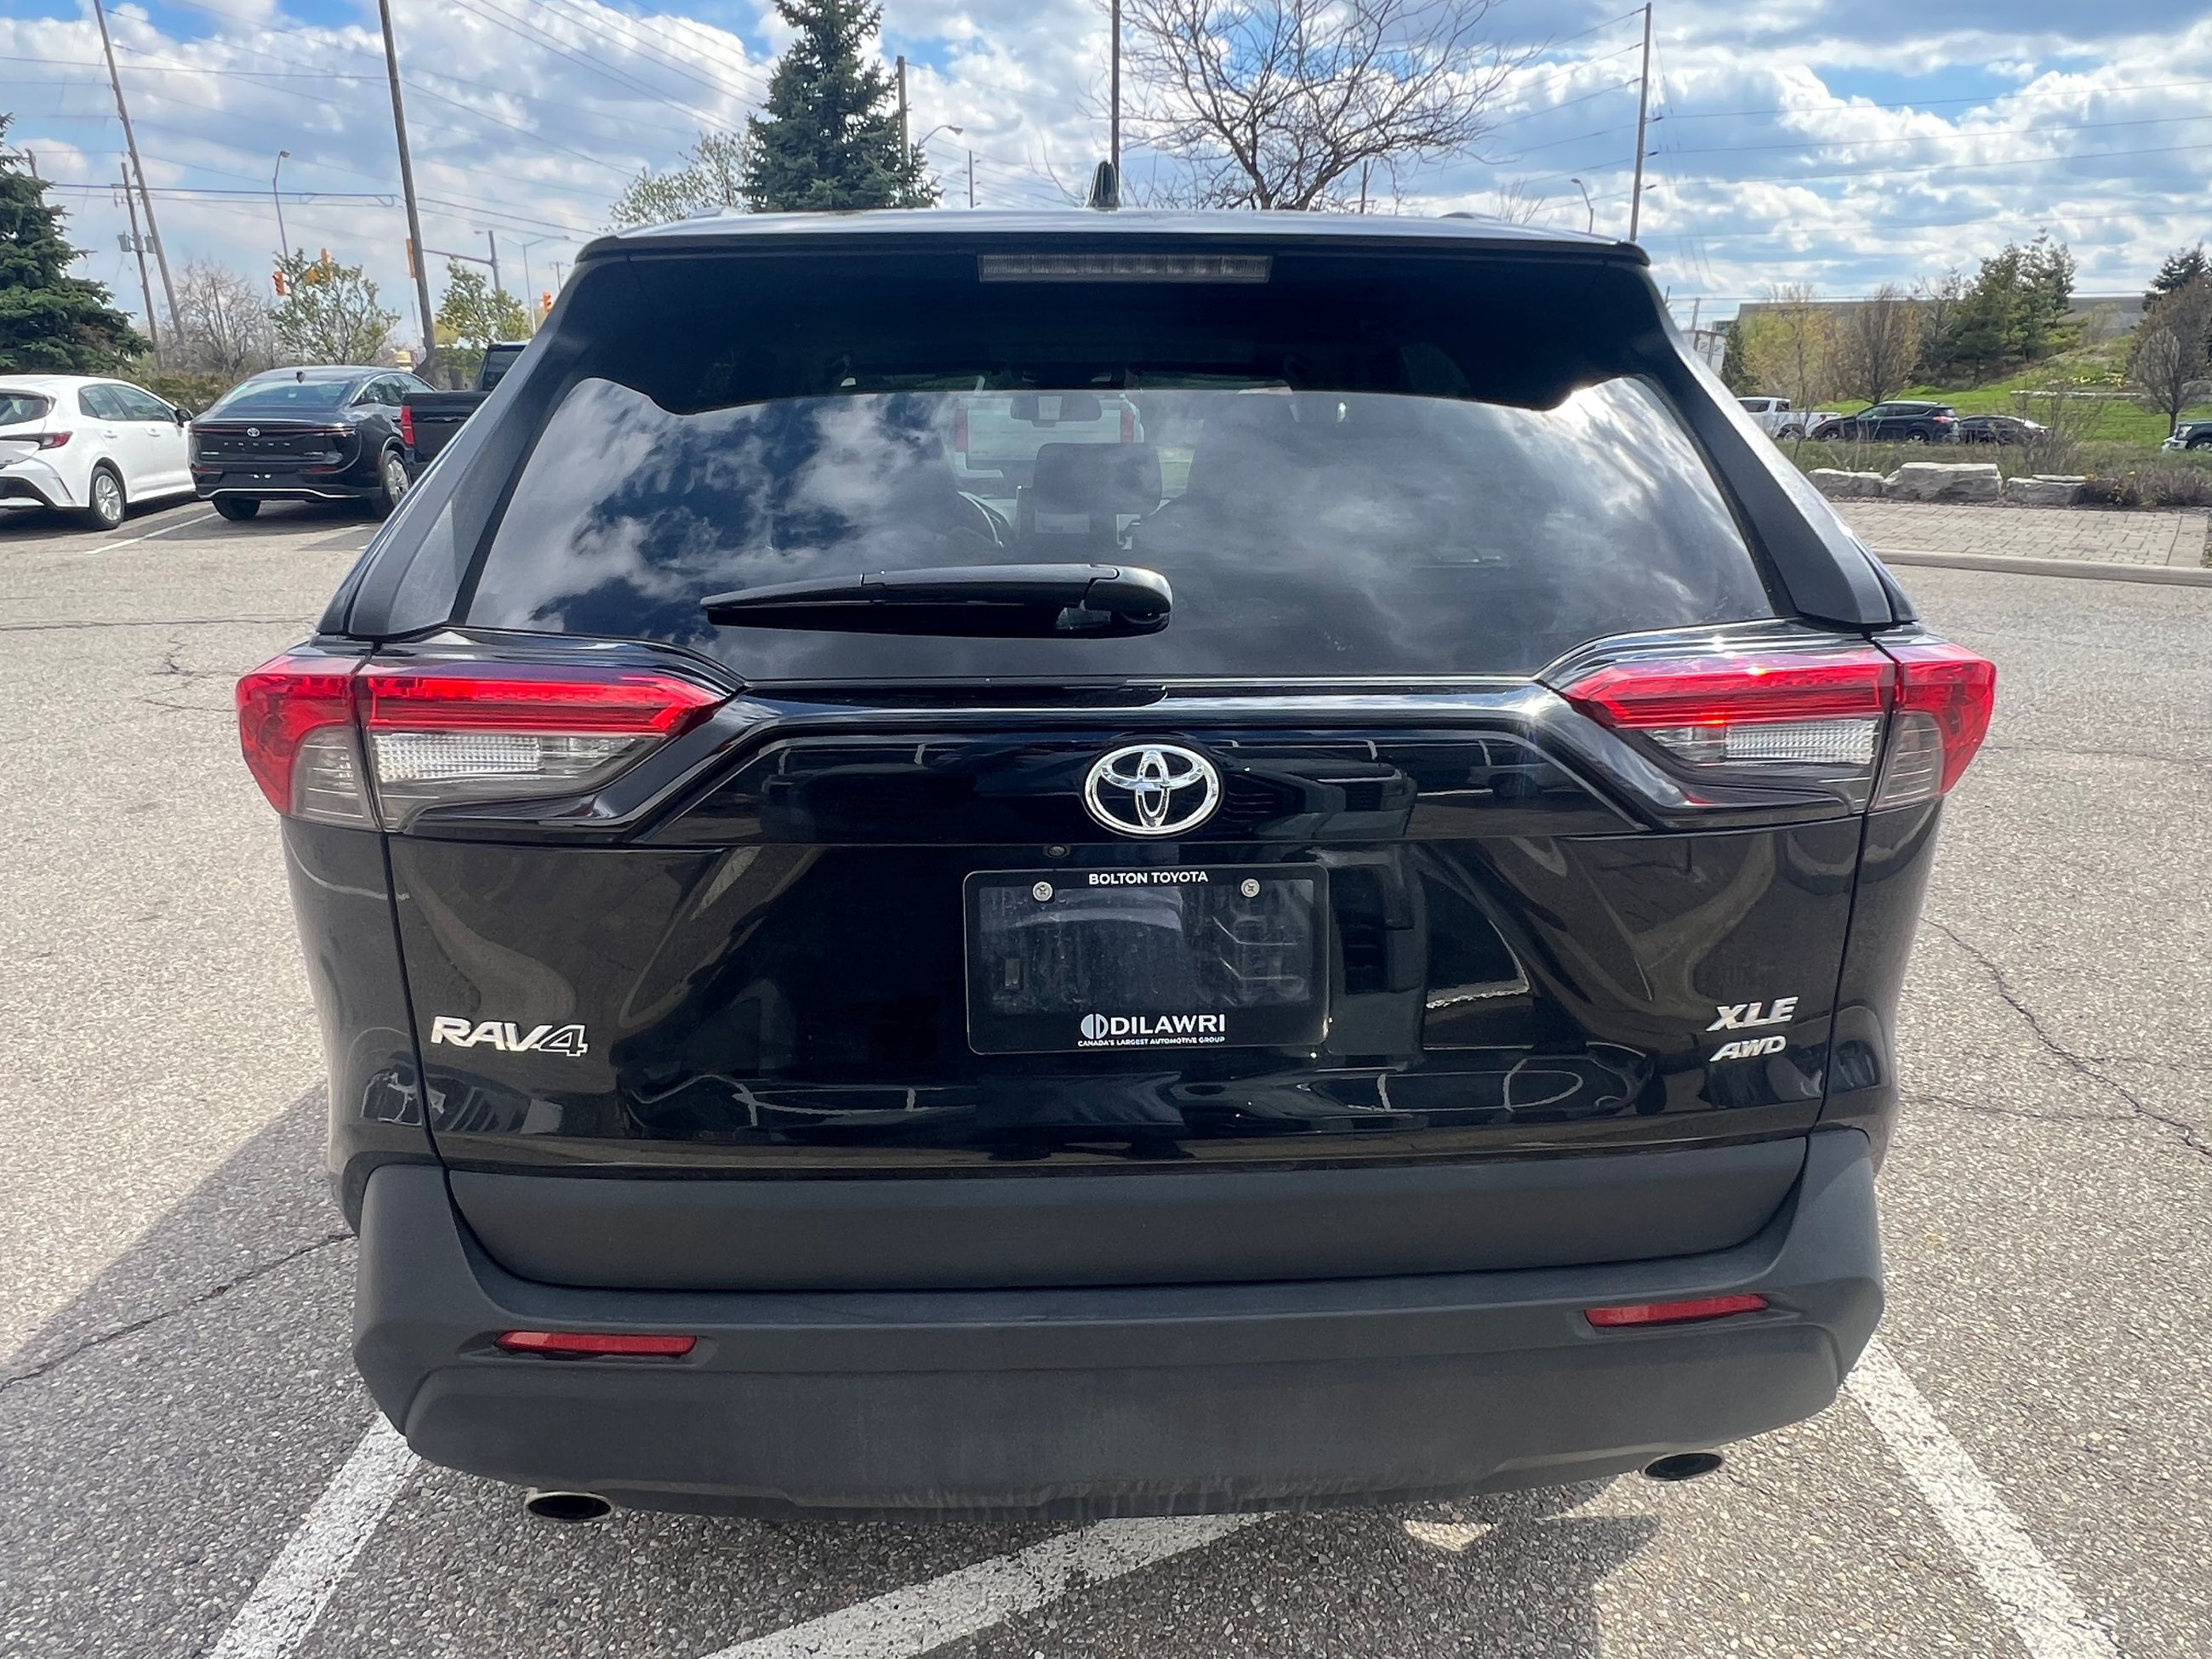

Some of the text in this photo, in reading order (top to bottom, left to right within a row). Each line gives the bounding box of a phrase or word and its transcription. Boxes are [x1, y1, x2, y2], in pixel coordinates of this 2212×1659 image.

[1088, 870, 1209, 885] BOLTON TOYOTA
[1110, 1013, 1226, 1035] DILAWRI
[1706, 996, 1799, 1032] XLE
[430, 1016, 589, 1058] RAV4
[1077, 1039, 1115, 1047] CANADA'S
[1149, 1036, 1198, 1045] AUTOMOTIVE
[1198, 1035, 1226, 1044] GROUP
[1708, 1035, 1787, 1062] AWD
